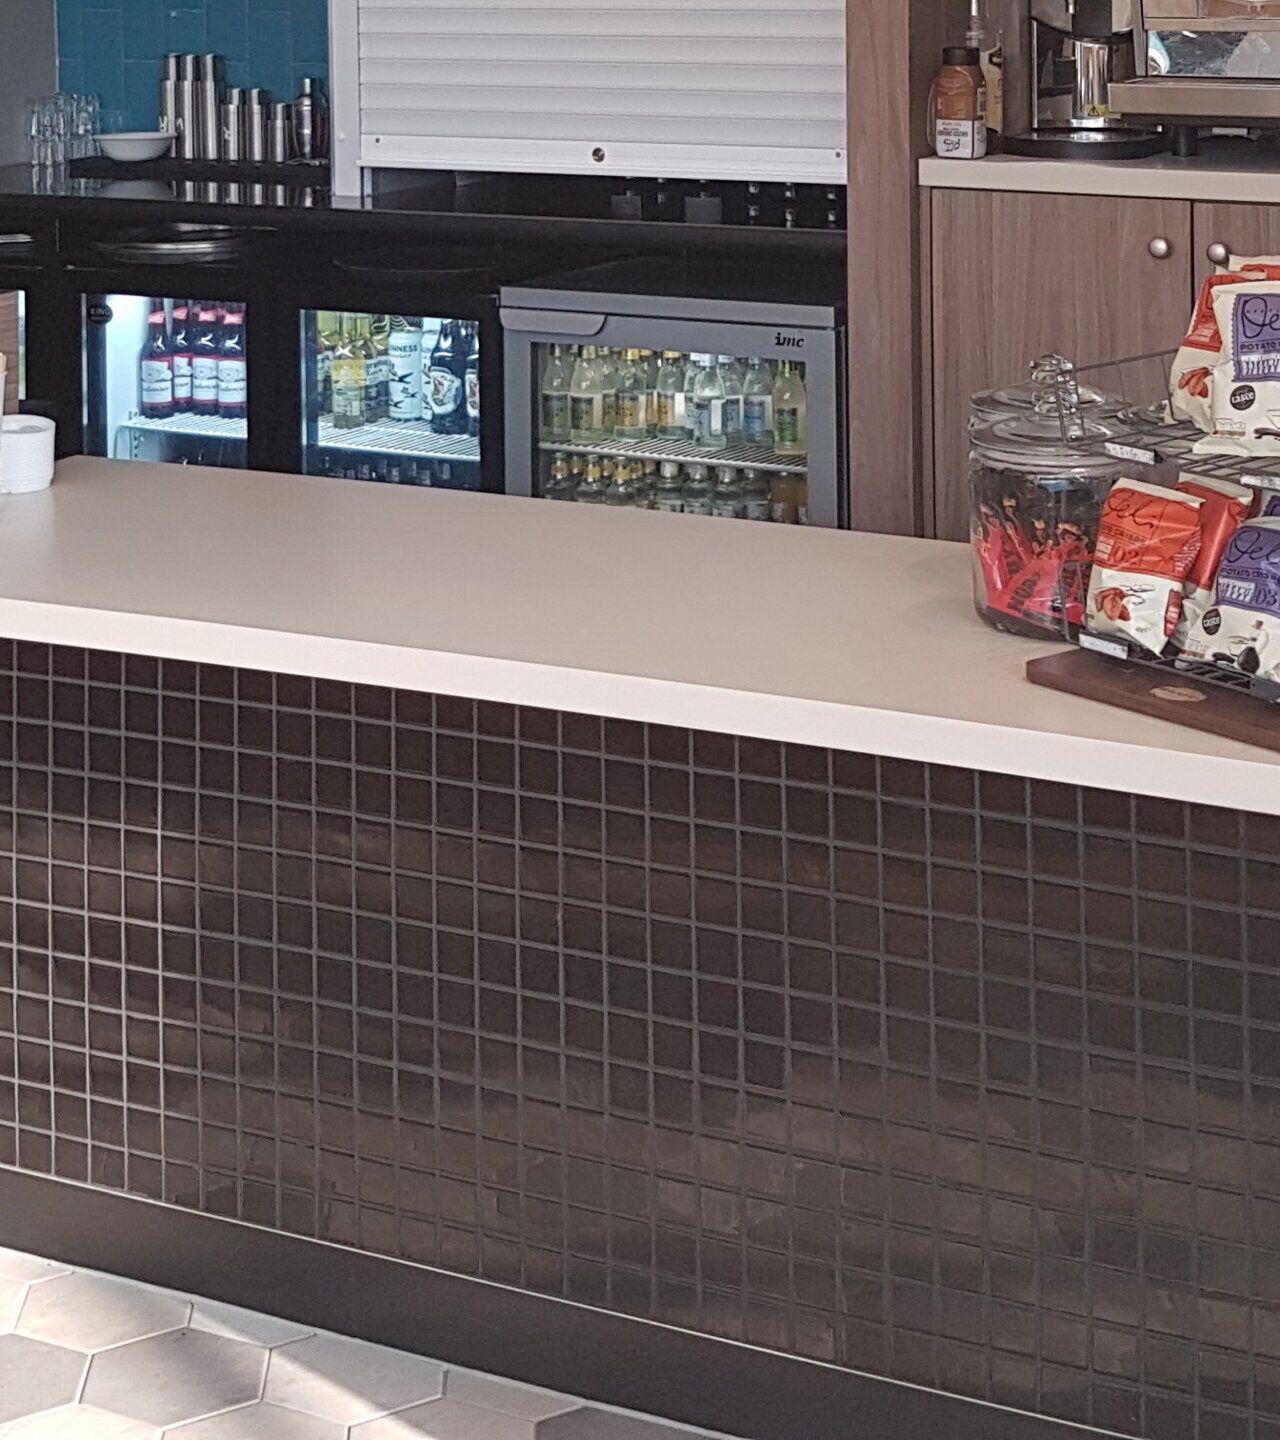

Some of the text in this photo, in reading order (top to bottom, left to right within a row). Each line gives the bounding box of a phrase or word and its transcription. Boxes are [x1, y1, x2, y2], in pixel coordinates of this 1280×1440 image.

[774, 332, 805, 348] imc
[1240, 341, 1277, 351] POTATO
[1220, 567, 1250, 578] POTATO
[1254, 585, 1279, 607] 03
